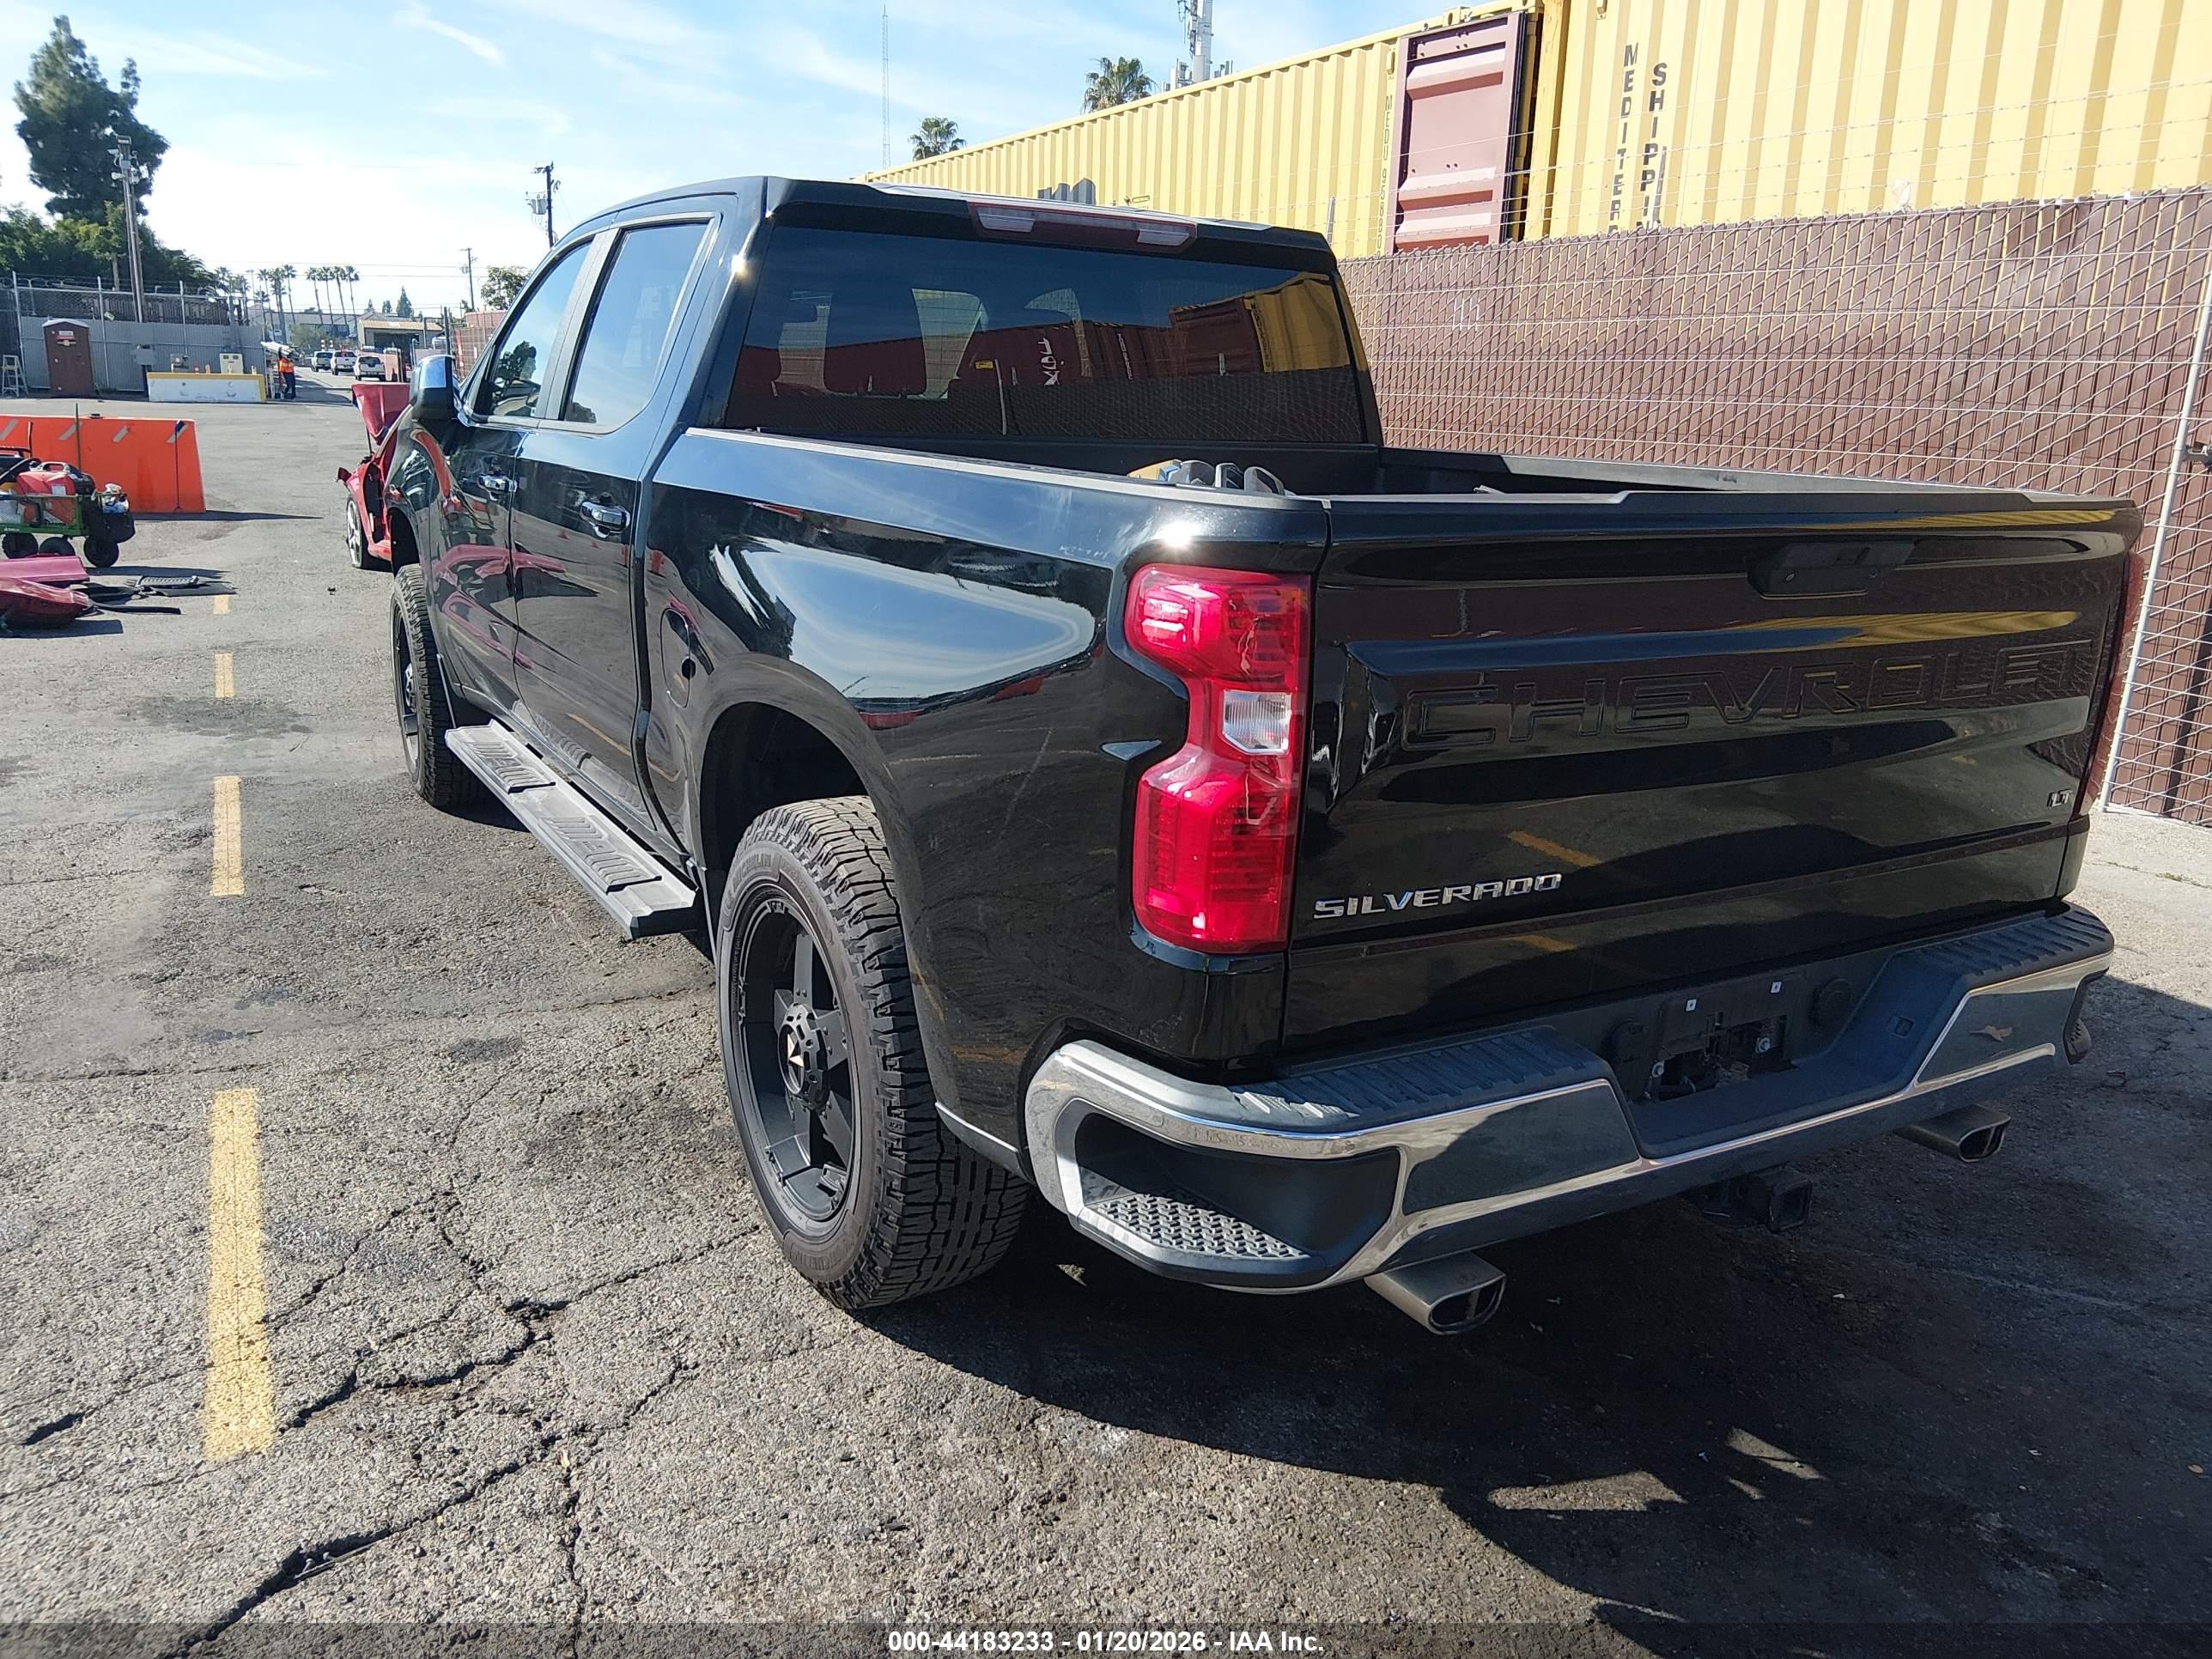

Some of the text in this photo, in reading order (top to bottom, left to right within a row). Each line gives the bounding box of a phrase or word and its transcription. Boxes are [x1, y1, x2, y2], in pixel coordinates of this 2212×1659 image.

[1401, 639, 2094, 751] CHEVROLET
[2047, 789, 2073, 807] LT
[1313, 872, 1563, 920] SILVERADO
